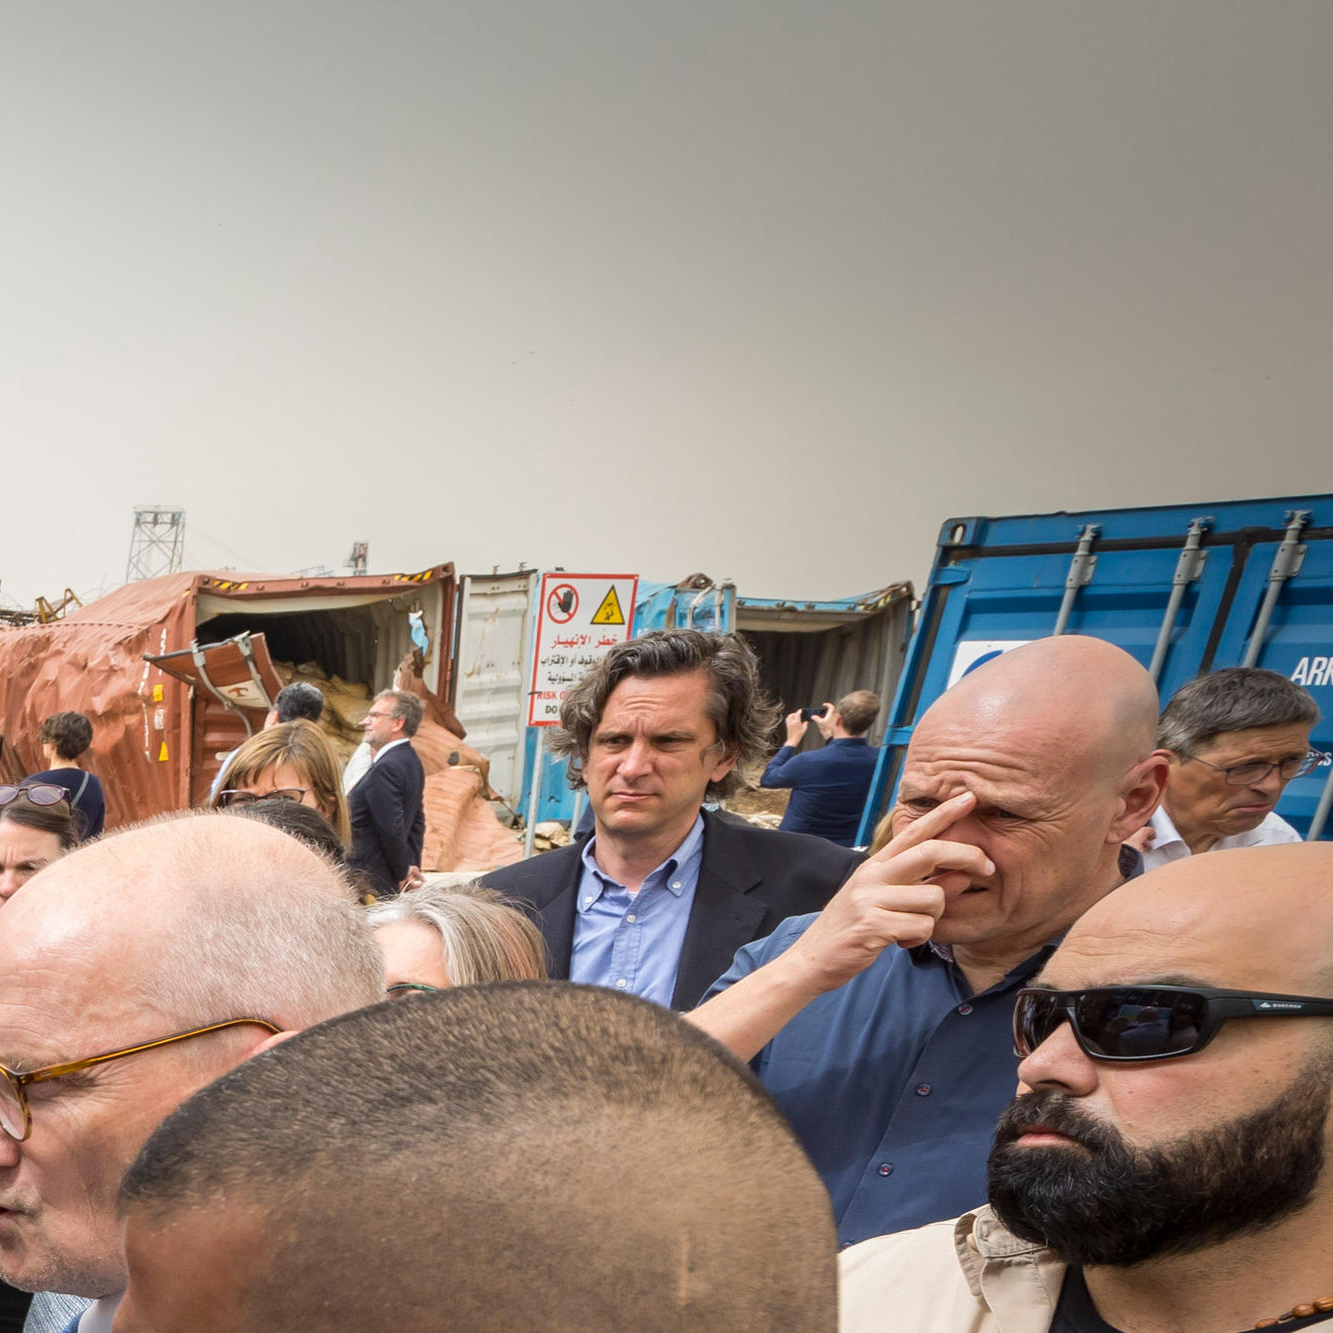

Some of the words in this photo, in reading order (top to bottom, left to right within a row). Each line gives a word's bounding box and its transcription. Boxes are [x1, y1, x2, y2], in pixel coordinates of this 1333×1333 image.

[594, 634, 618, 649] خطر
[537, 691, 557, 700] RISK
[545, 705, 558, 714] DO
